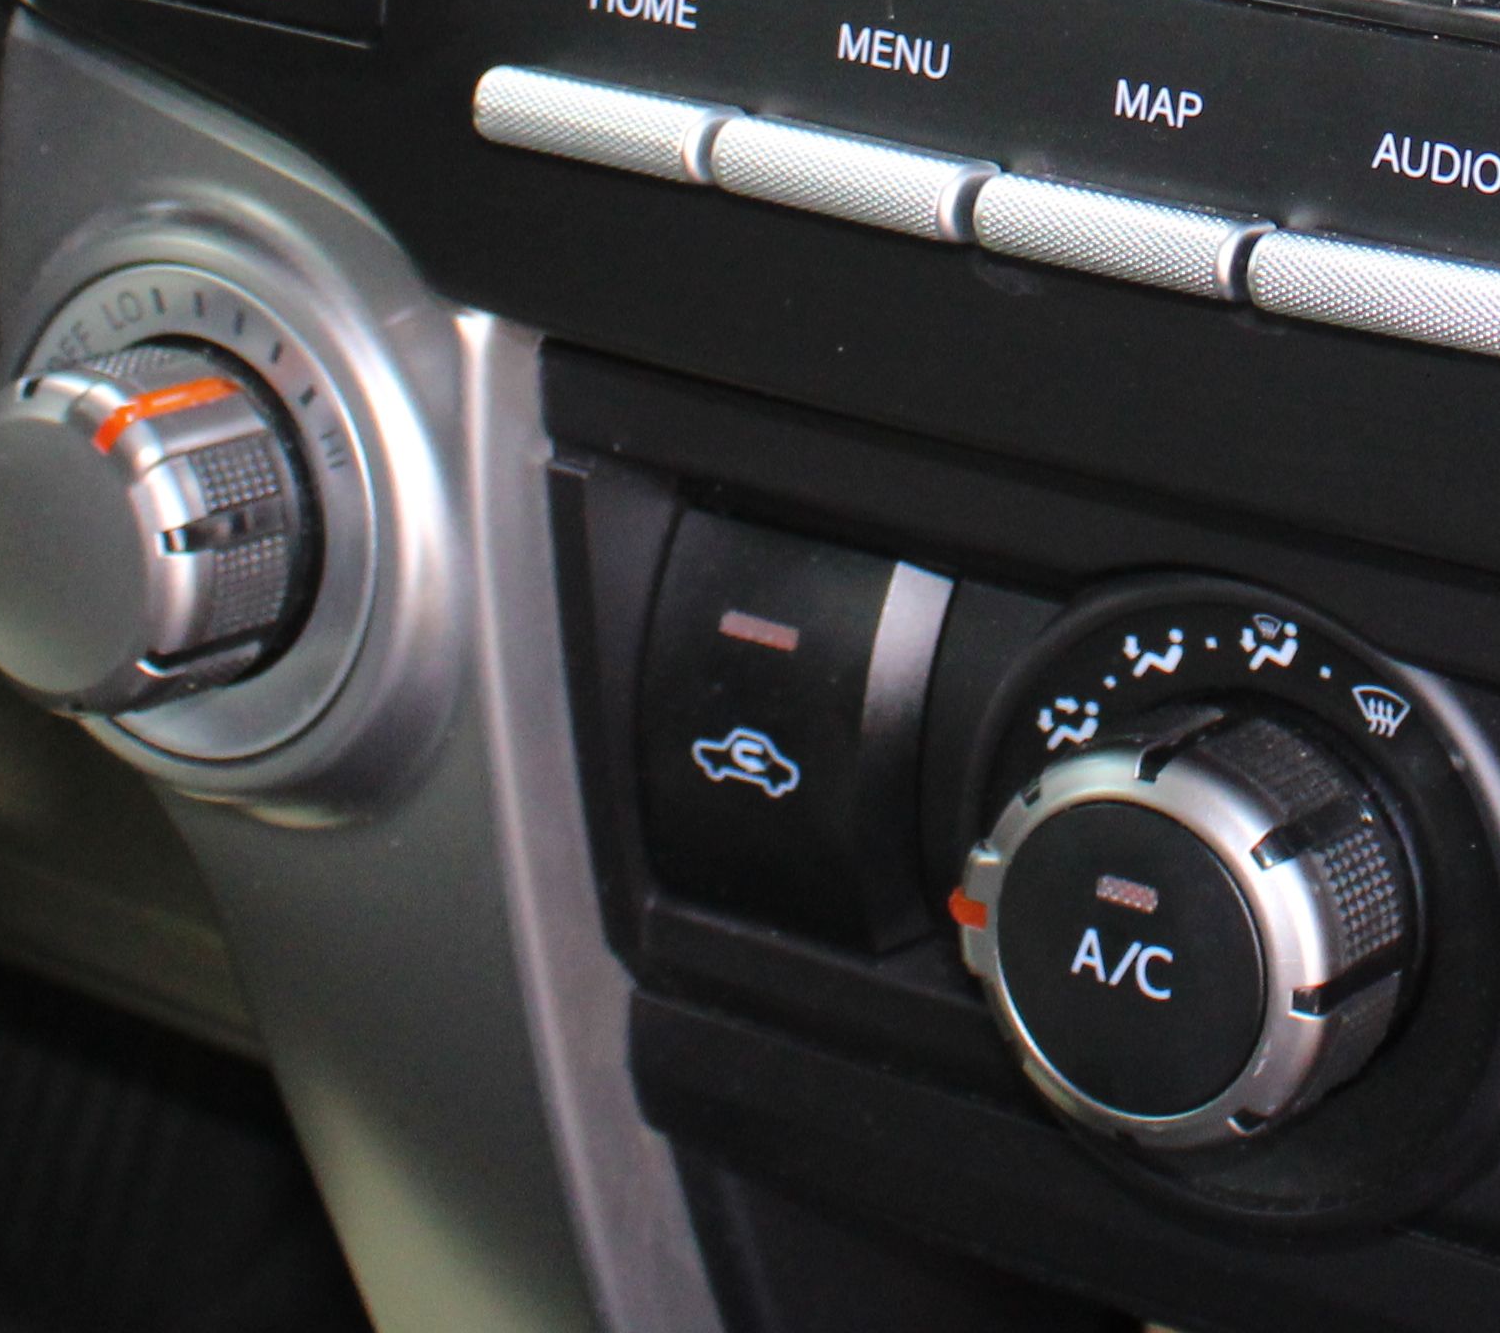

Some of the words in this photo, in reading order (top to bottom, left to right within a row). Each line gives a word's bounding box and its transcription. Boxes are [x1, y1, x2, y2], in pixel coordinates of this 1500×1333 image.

[836, 23, 952, 81] MENU
[1113, 77, 1203, 130] MAP
[102, 289, 144, 331] LO
[1069, 927, 1175, 1002] A/C
